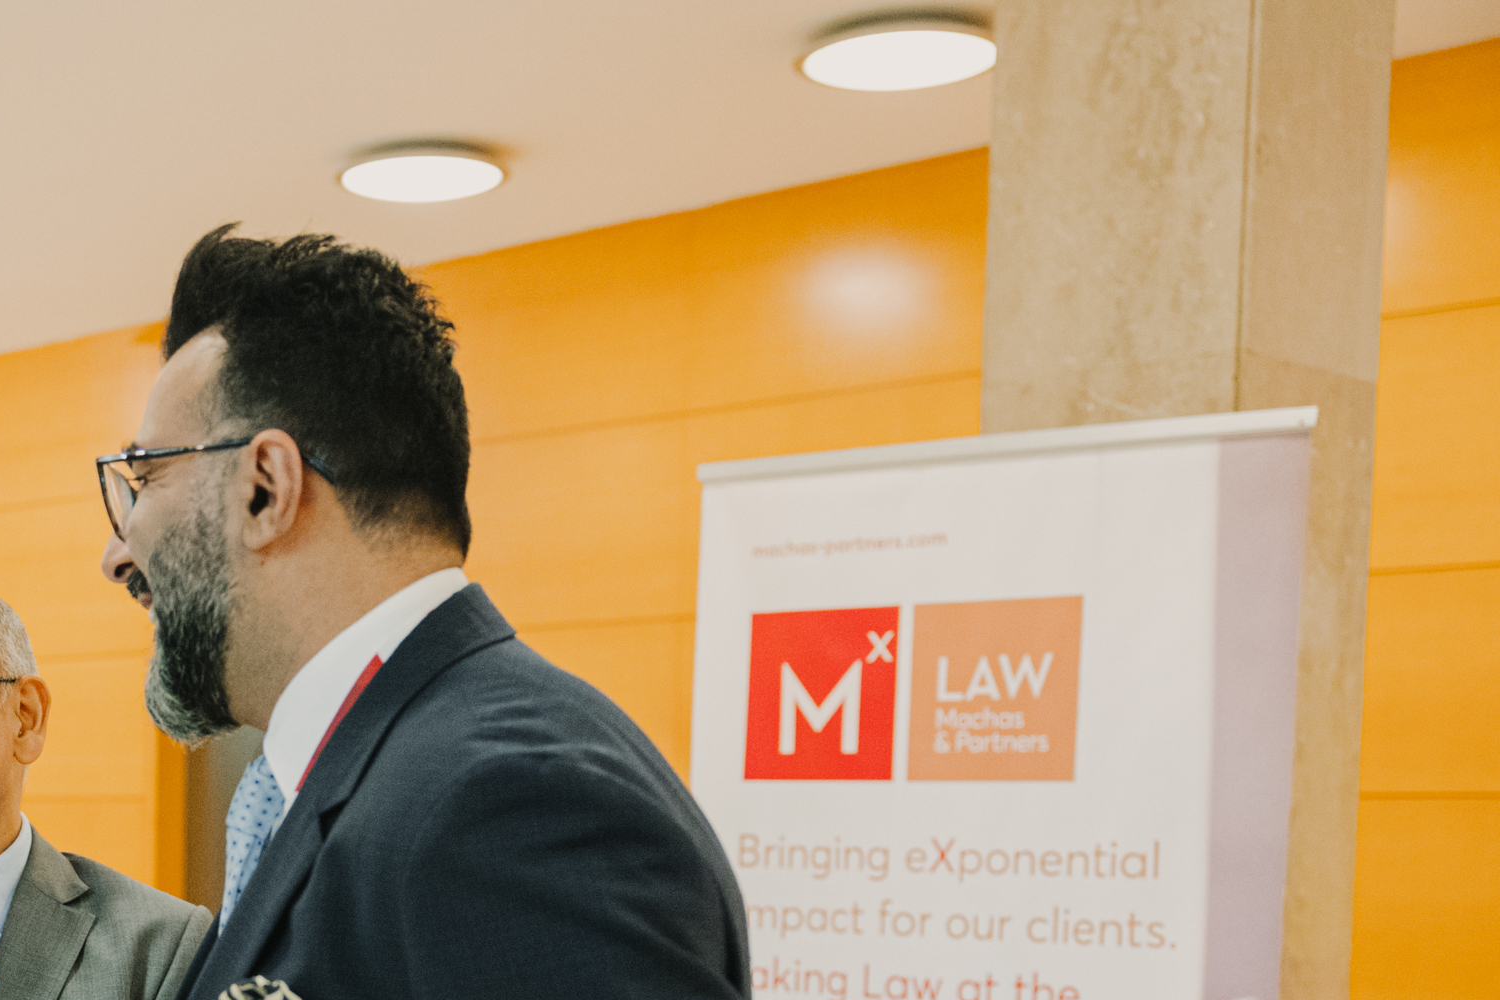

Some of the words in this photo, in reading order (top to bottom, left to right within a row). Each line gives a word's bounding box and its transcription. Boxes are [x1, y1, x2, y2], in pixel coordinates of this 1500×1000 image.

[936, 651, 1055, 702] LAW
[934, 706, 1026, 732] Machas
[933, 731, 951, 755] &
[955, 729, 1050, 753] Partners
[737, 832, 891, 882] Bringing
[905, 836, 1161, 884] eXponential
[746, 901, 864, 940] mpact
[878, 898, 933, 937] for
[945, 913, 1014, 942] our
[1026, 906, 1177, 949] clients.
[861, 963, 944, 1000] Law
